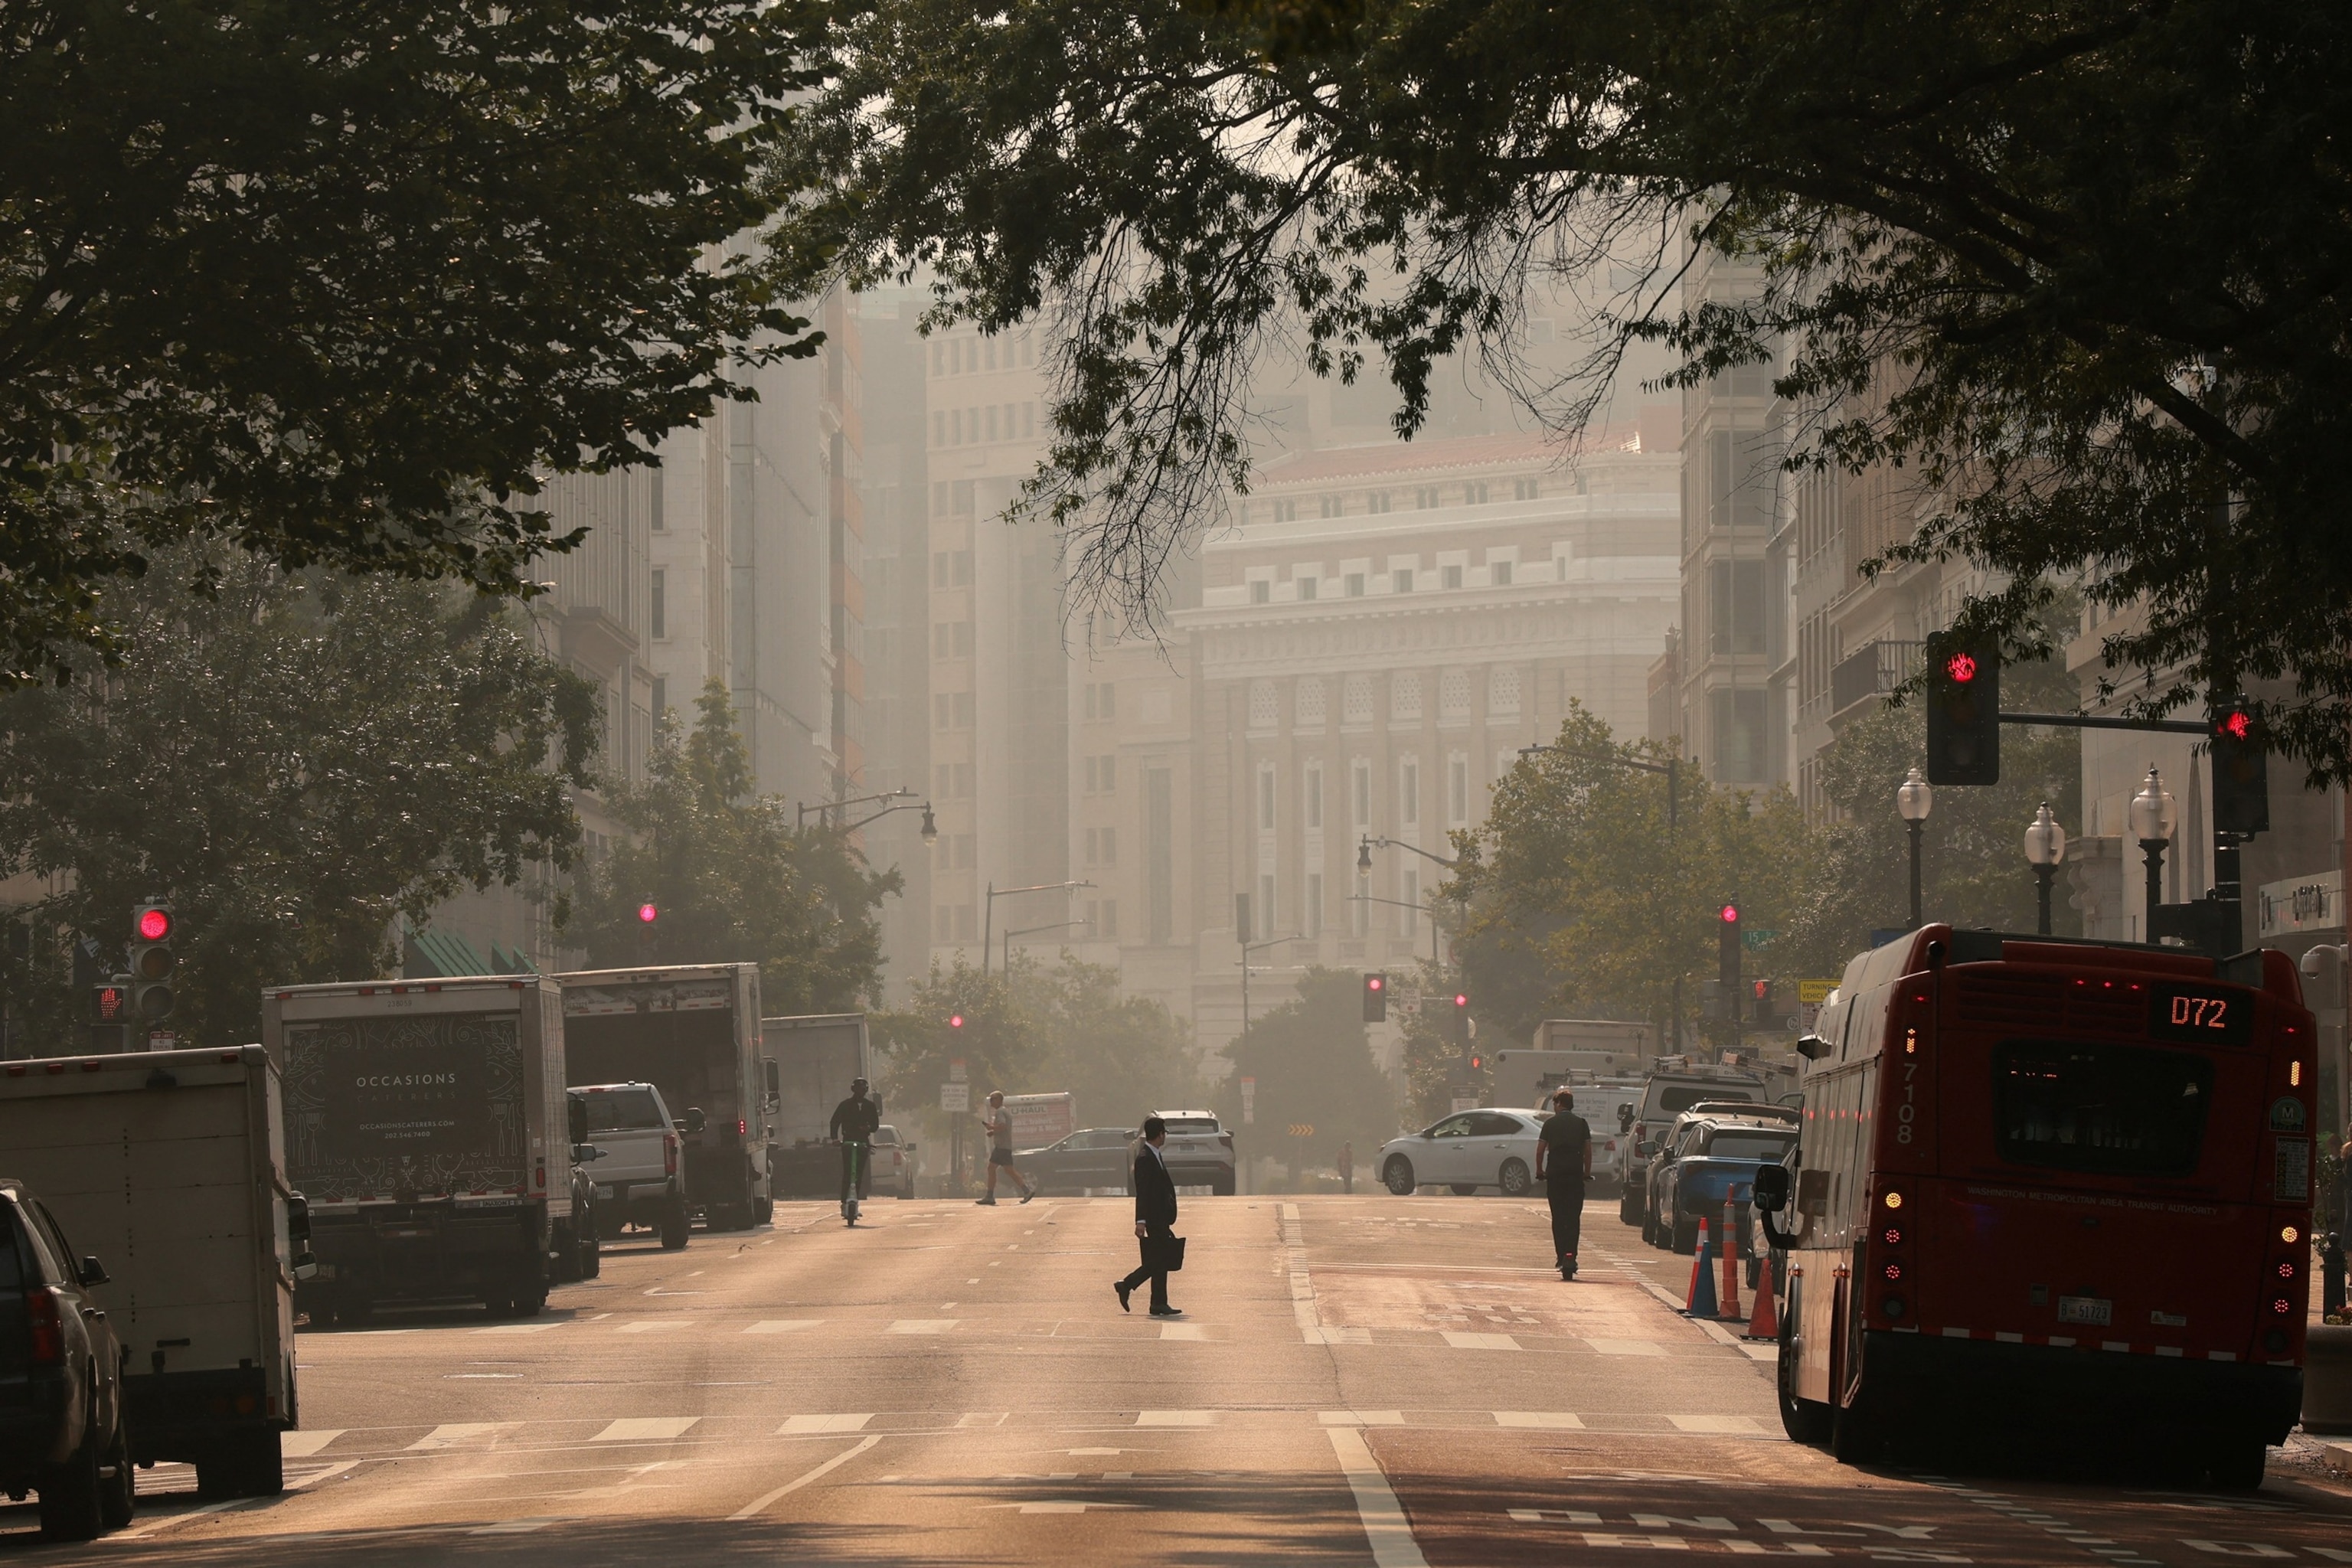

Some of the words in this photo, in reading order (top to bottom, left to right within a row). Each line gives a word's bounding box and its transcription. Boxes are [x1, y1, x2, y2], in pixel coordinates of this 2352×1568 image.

[1749, 932, 1759, 942] 15
[2171, 996, 2226, 1028] D72
[356, 1073, 456, 1087] OCCASIONS
[357, 1092, 456, 1103] CATERERS
[1896, 1063, 1918, 1144] 7108
[1011, 1106, 1047, 1115] U-HAUL
[2282, 1107, 2294, 1119] M
[359, 1120, 456, 1130] OCCASIONSCATERERS.COM
[384, 1131, 431, 1139] 202.546.7400
[1967, 1187, 2026, 1199] WASHINGTON
[2028, 1191, 2096, 1205] METROPOLITAN
[2099, 1198, 2123, 1207] AREA
[2126, 1200, 2164, 1211] TRANSIT
[2167, 1204, 2219, 1216] AUTHORITY
[2060, 1304, 2067, 1316] B
[2079, 1306, 2108, 1320] 51723
[1506, 1508, 1939, 1540] ONLY
